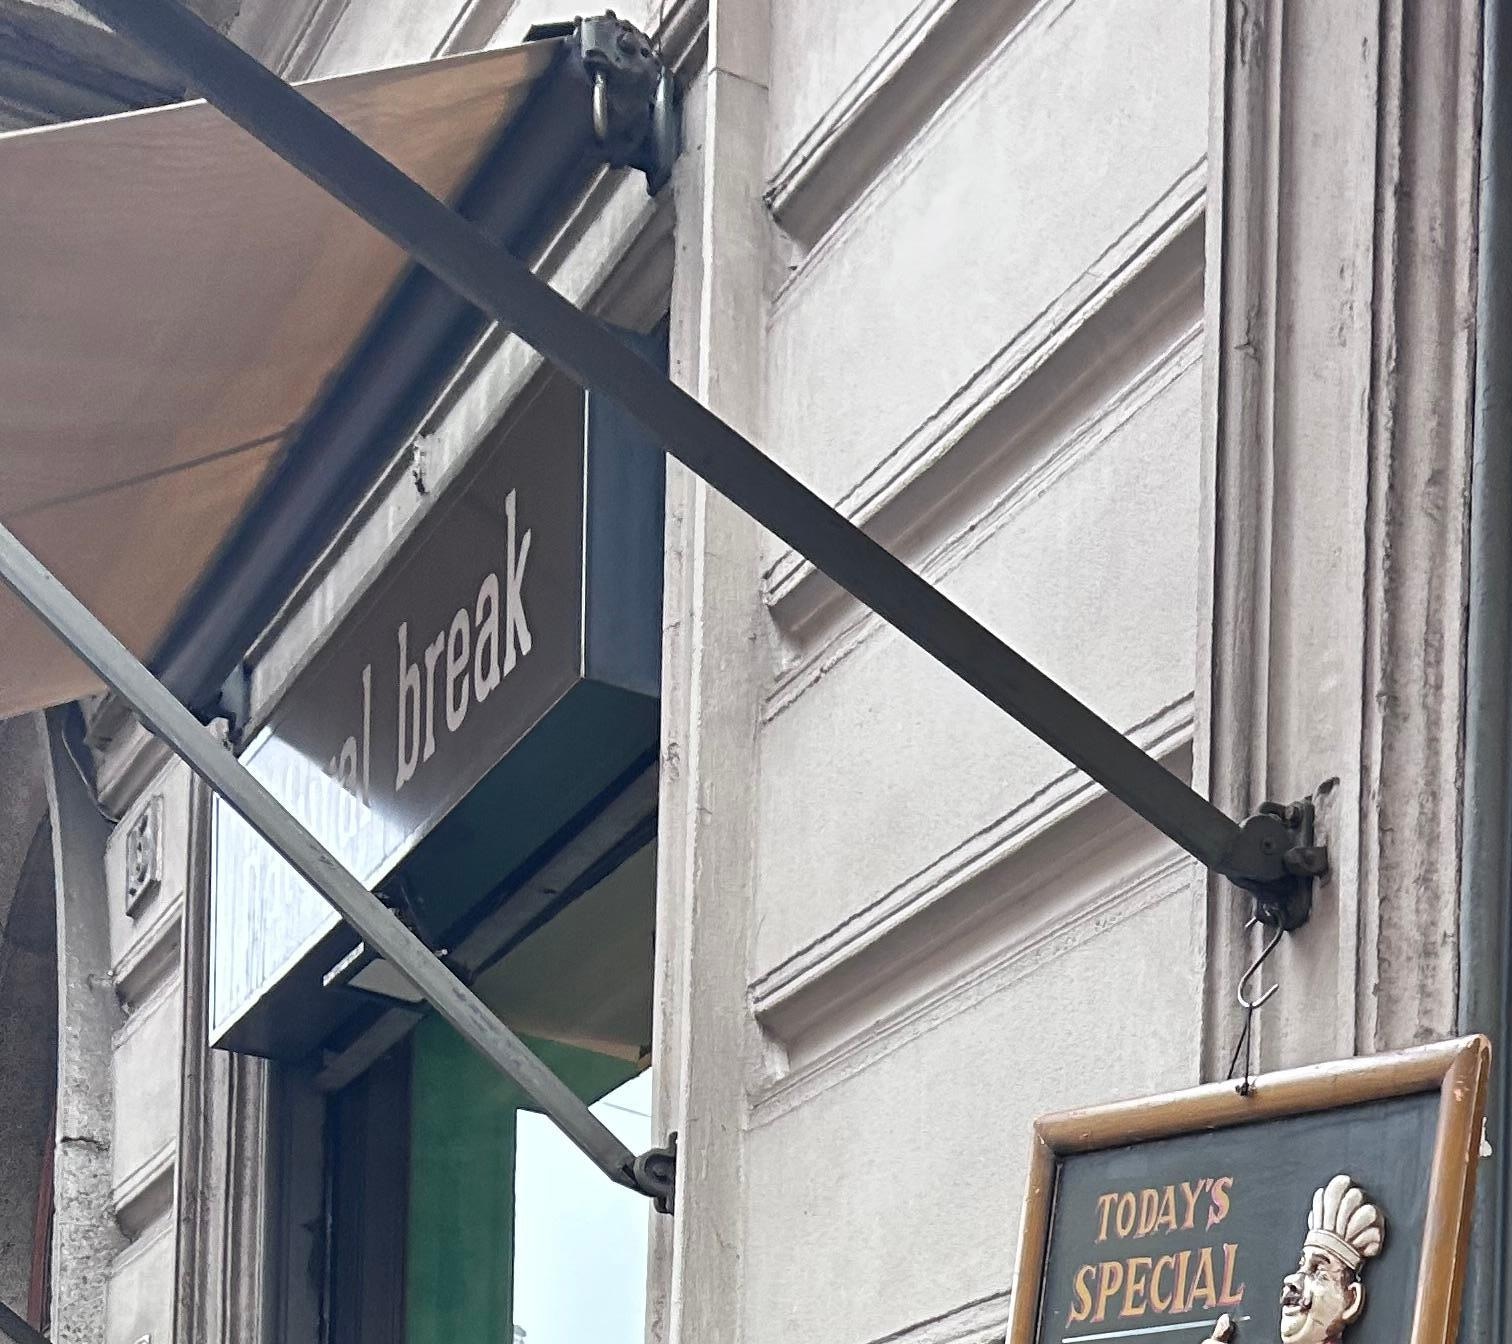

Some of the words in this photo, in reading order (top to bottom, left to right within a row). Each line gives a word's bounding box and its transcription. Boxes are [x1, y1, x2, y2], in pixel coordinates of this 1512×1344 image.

[396, 489, 532, 791] break
[1095, 1176, 1235, 1246] TODAY'S
[1066, 1243, 1246, 1328] SPECIAL
